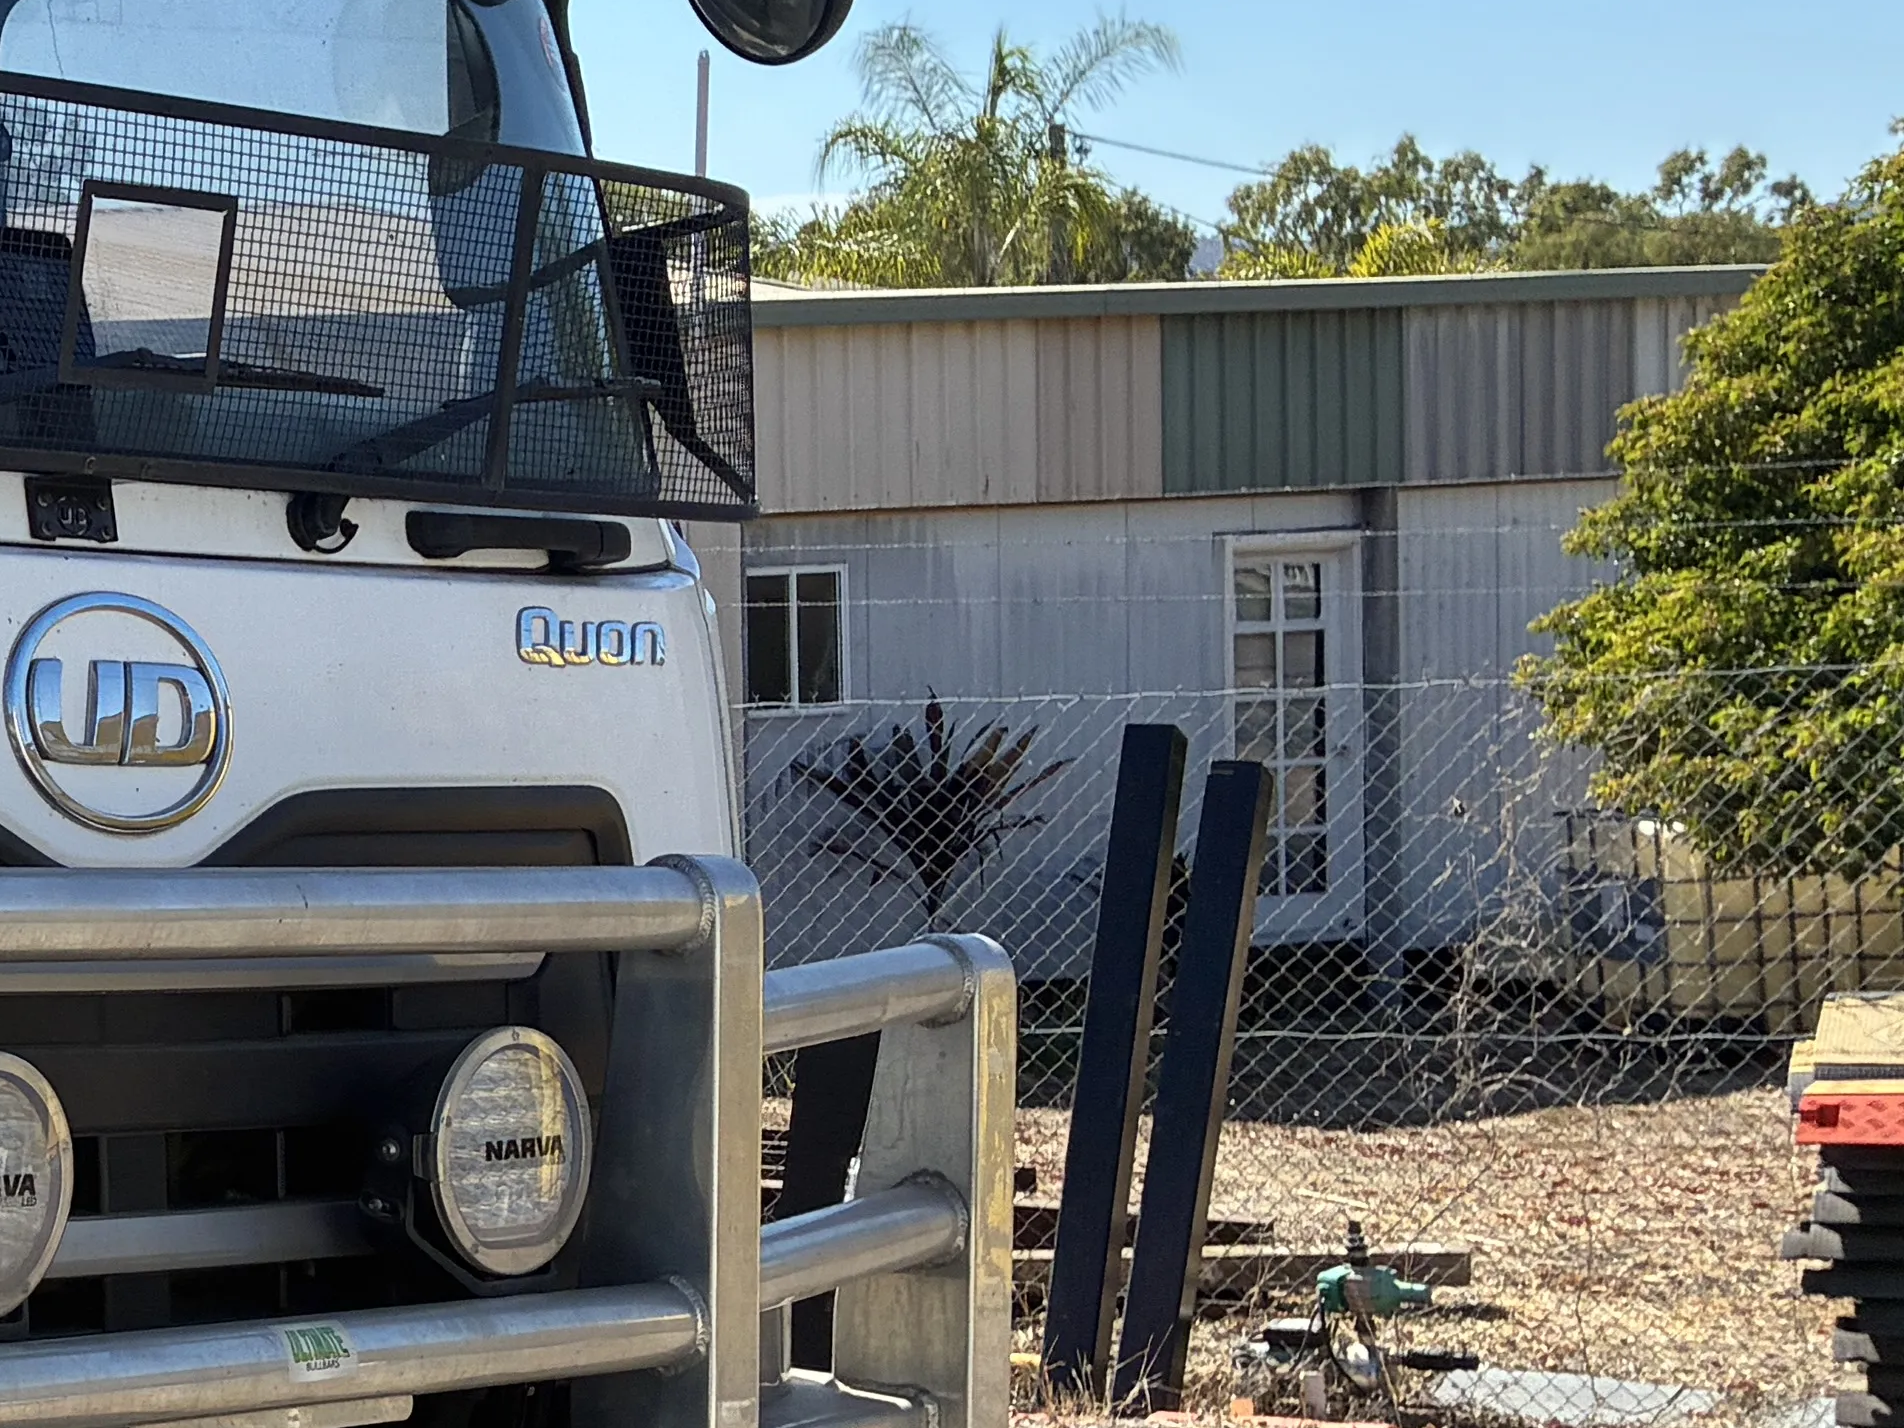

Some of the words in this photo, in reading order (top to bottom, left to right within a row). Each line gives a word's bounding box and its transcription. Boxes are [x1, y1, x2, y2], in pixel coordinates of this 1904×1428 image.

[515, 605, 667, 668] Quon
[28, 658, 217, 767] UD
[485, 1135, 566, 1164] NARVA
